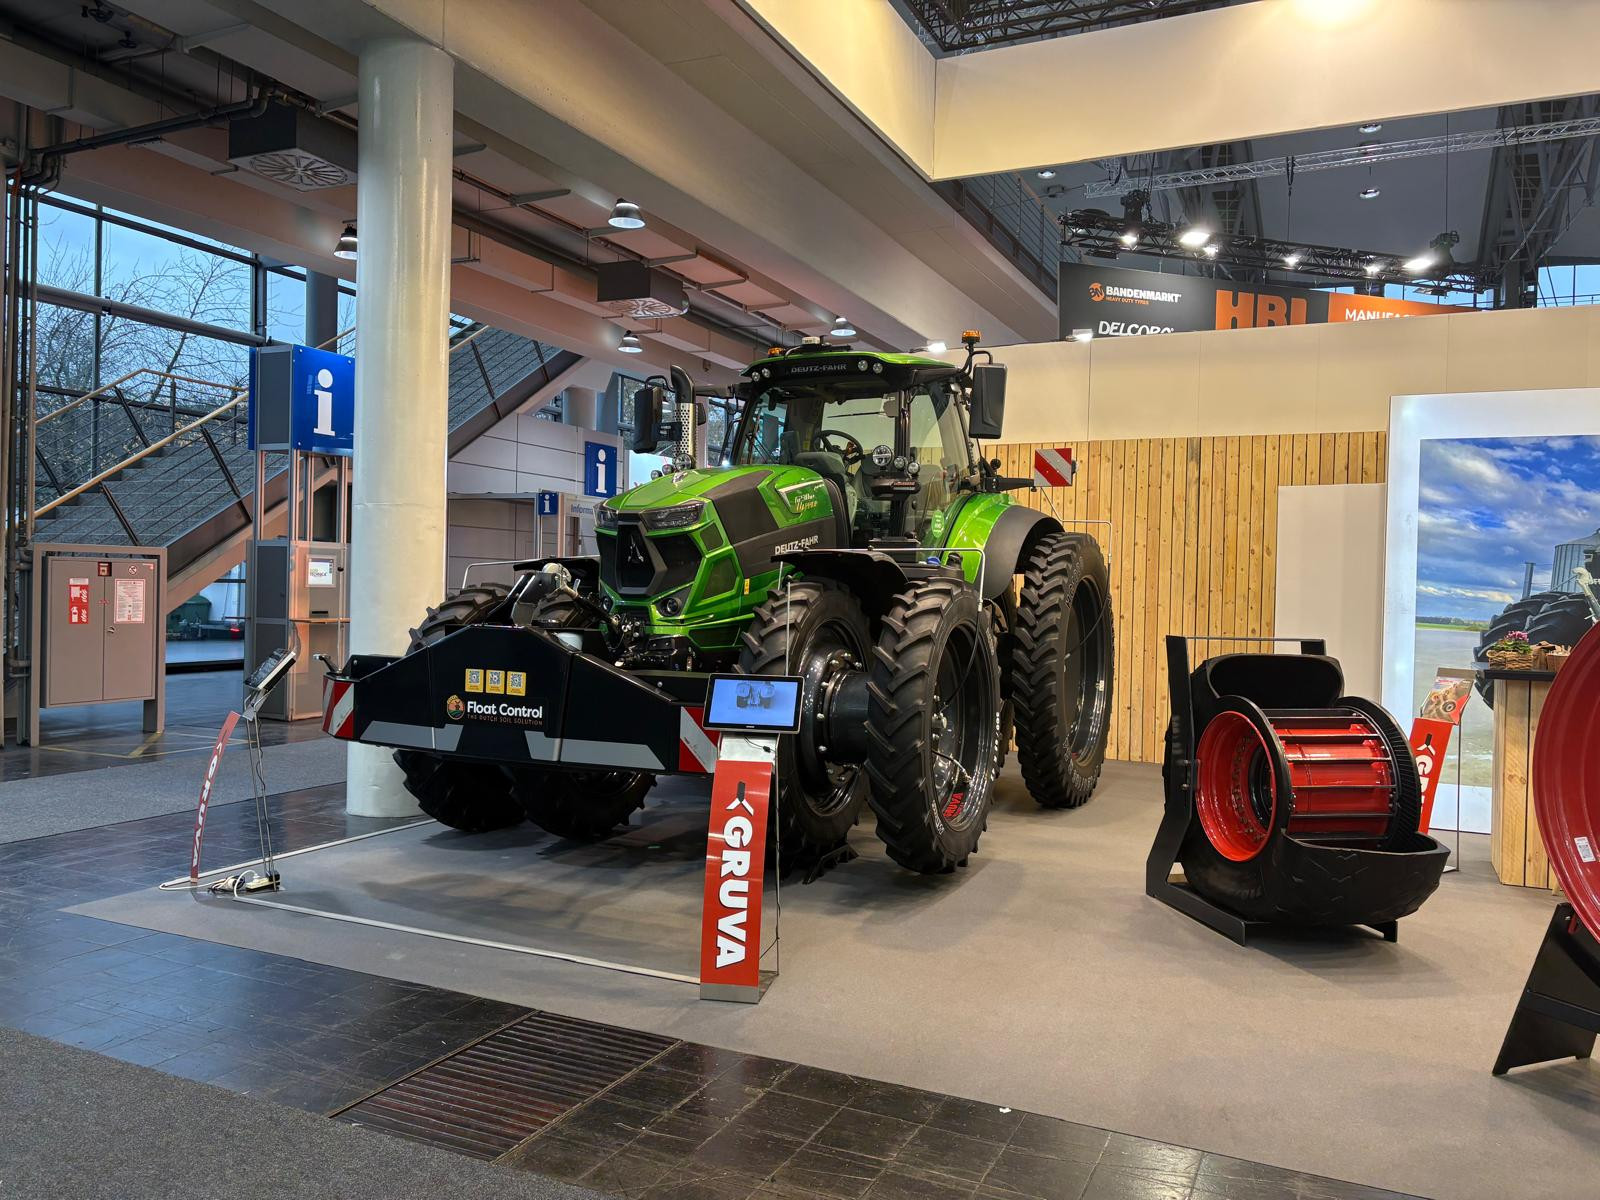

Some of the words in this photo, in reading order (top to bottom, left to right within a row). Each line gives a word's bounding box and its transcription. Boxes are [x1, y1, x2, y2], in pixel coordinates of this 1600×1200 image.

[1105, 286, 1180, 303] BANDENMARKT
[791, 364, 847, 373] DEUTZ-FAHR
[774, 535, 819, 556] DEUTZ-FAHR
[467, 701, 497, 715] Float
[499, 703, 543, 719] Control
[514, 718, 543, 726] SOLUTION
[715, 815, 753, 968] GRUVA
